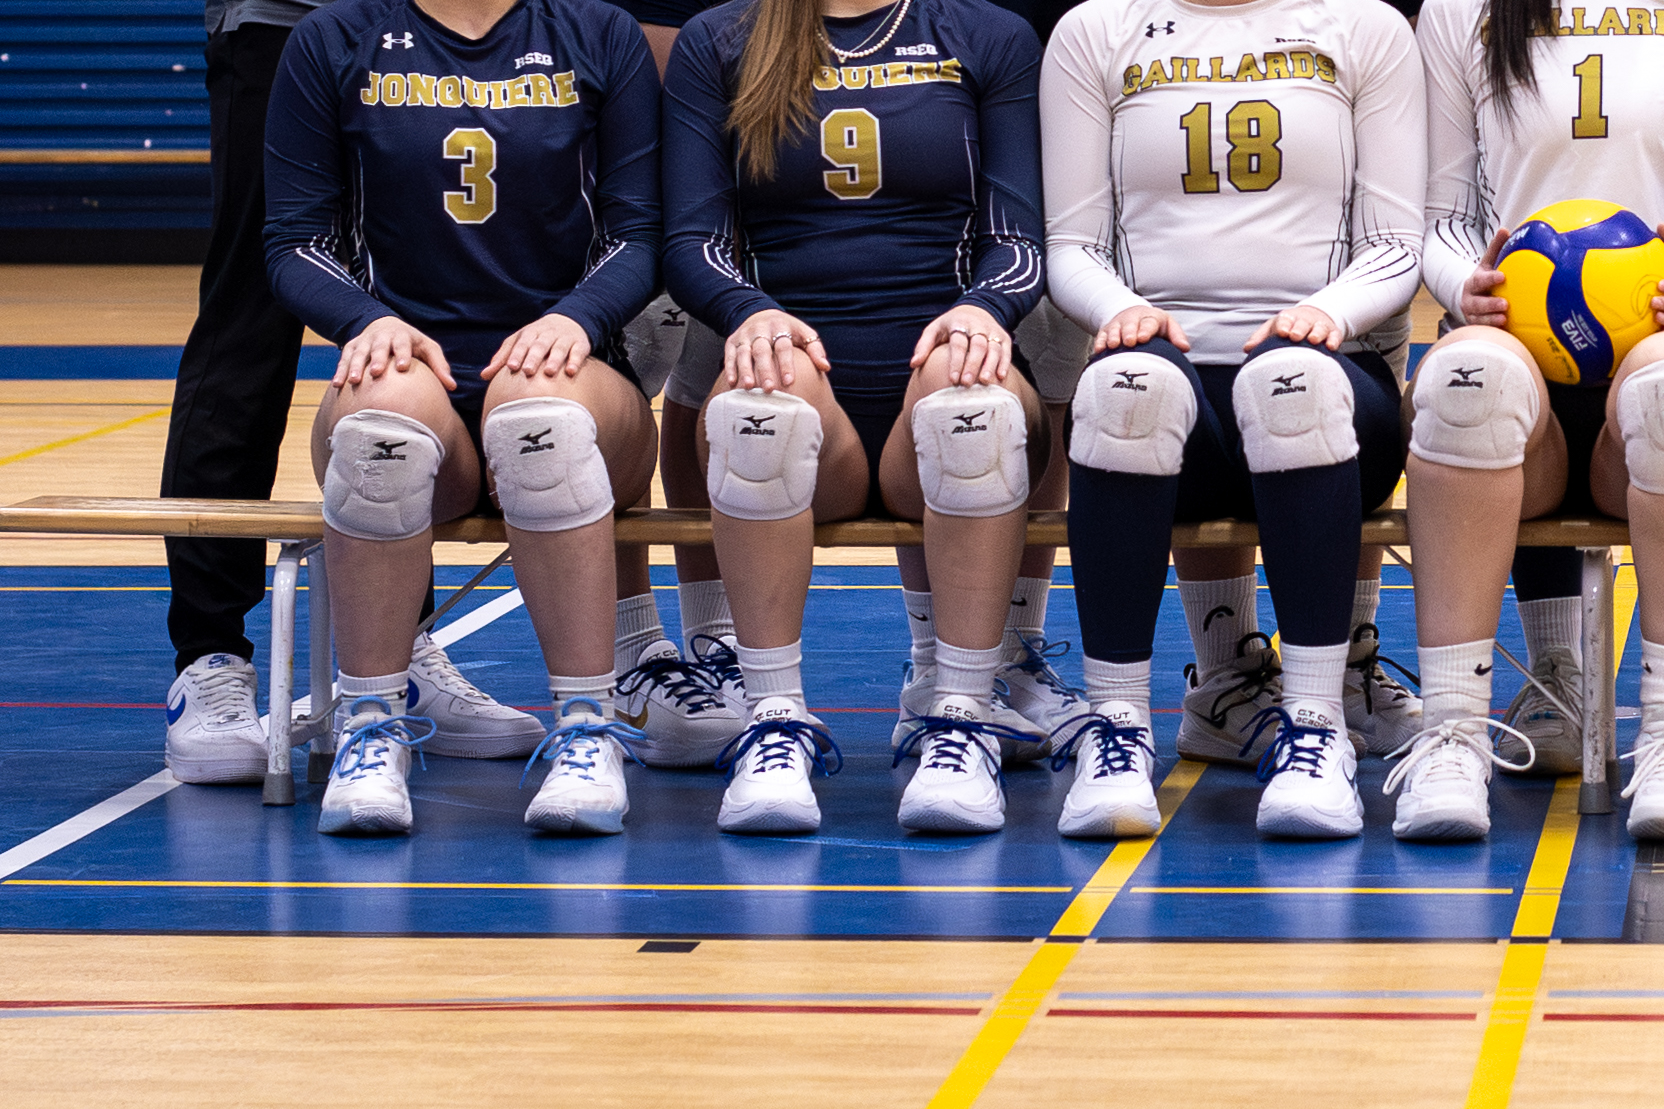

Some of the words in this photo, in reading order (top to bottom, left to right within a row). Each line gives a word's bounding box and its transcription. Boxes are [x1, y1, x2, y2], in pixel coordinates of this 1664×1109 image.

[514, 52, 553, 69] RSEQ
[895, 44, 938, 56] RSEQ
[360, 70, 580, 110] JONQUIERE
[813, 58, 962, 91] QUIERE
[1122, 51, 1337, 96] GAILLARDS
[1571, 53, 1609, 140] 1
[820, 108, 883, 201] 9
[1179, 99, 1283, 194] 18
[442, 127, 497, 226] 3
[1561, 319, 1588, 351] FIVB
